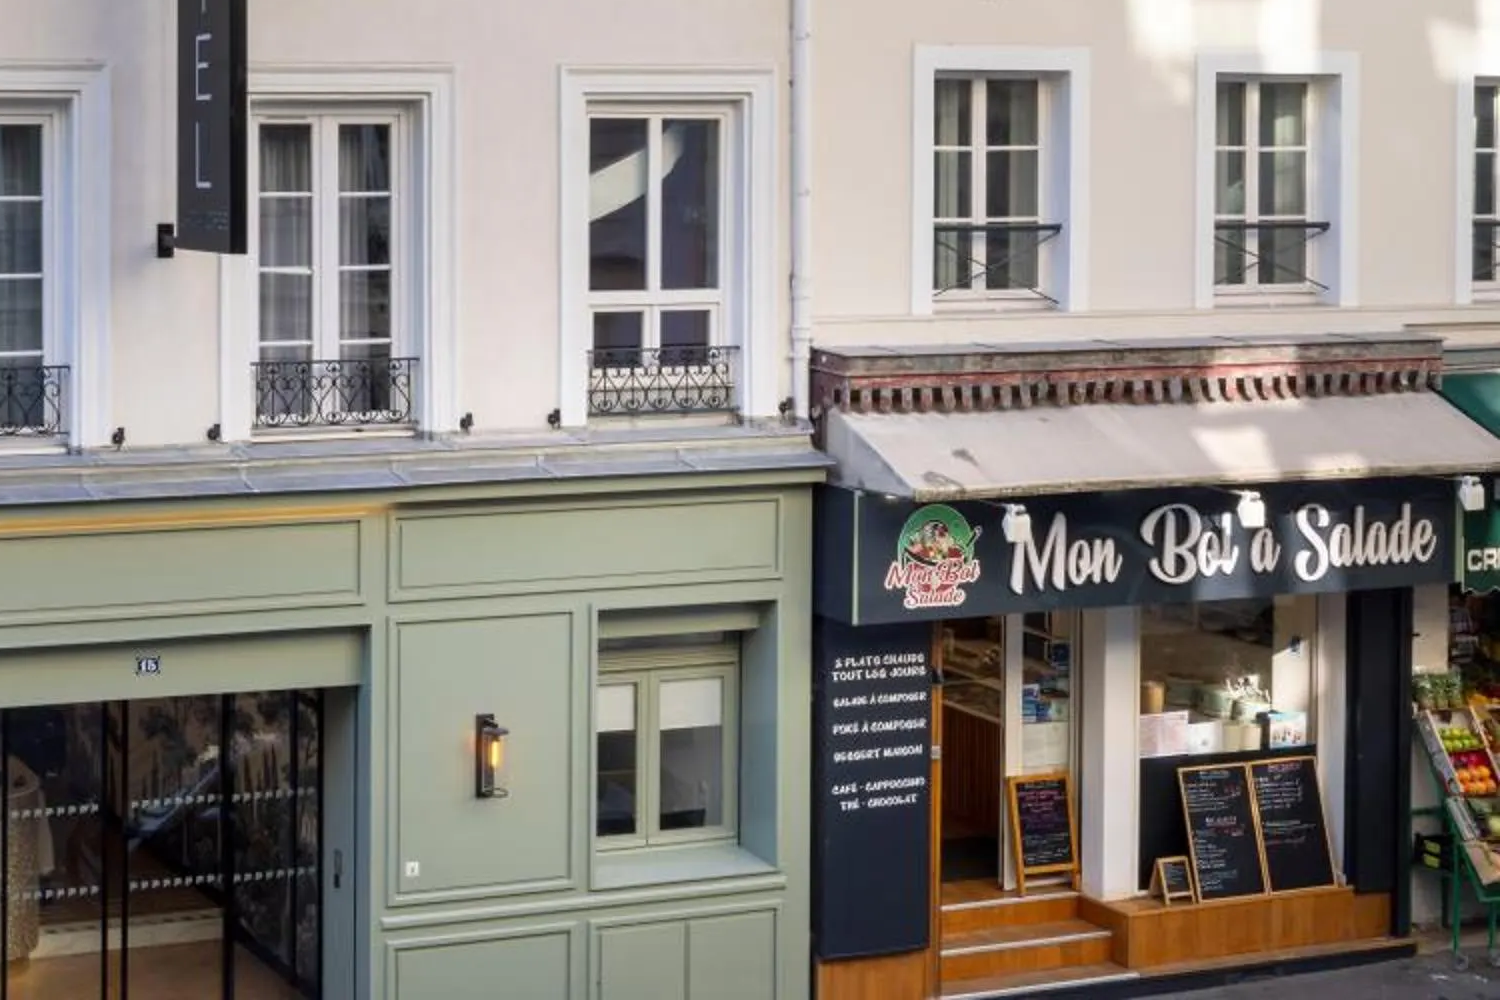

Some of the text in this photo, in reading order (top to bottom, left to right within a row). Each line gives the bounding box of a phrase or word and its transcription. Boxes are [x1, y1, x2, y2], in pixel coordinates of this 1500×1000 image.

[1010, 510, 1123, 596] Mon
[1140, 502, 1240, 584] Bol
[1294, 502, 1437, 582] Salade
[1467, 547, 1500, 571] CR
[832, 670, 862, 682] TOUT
